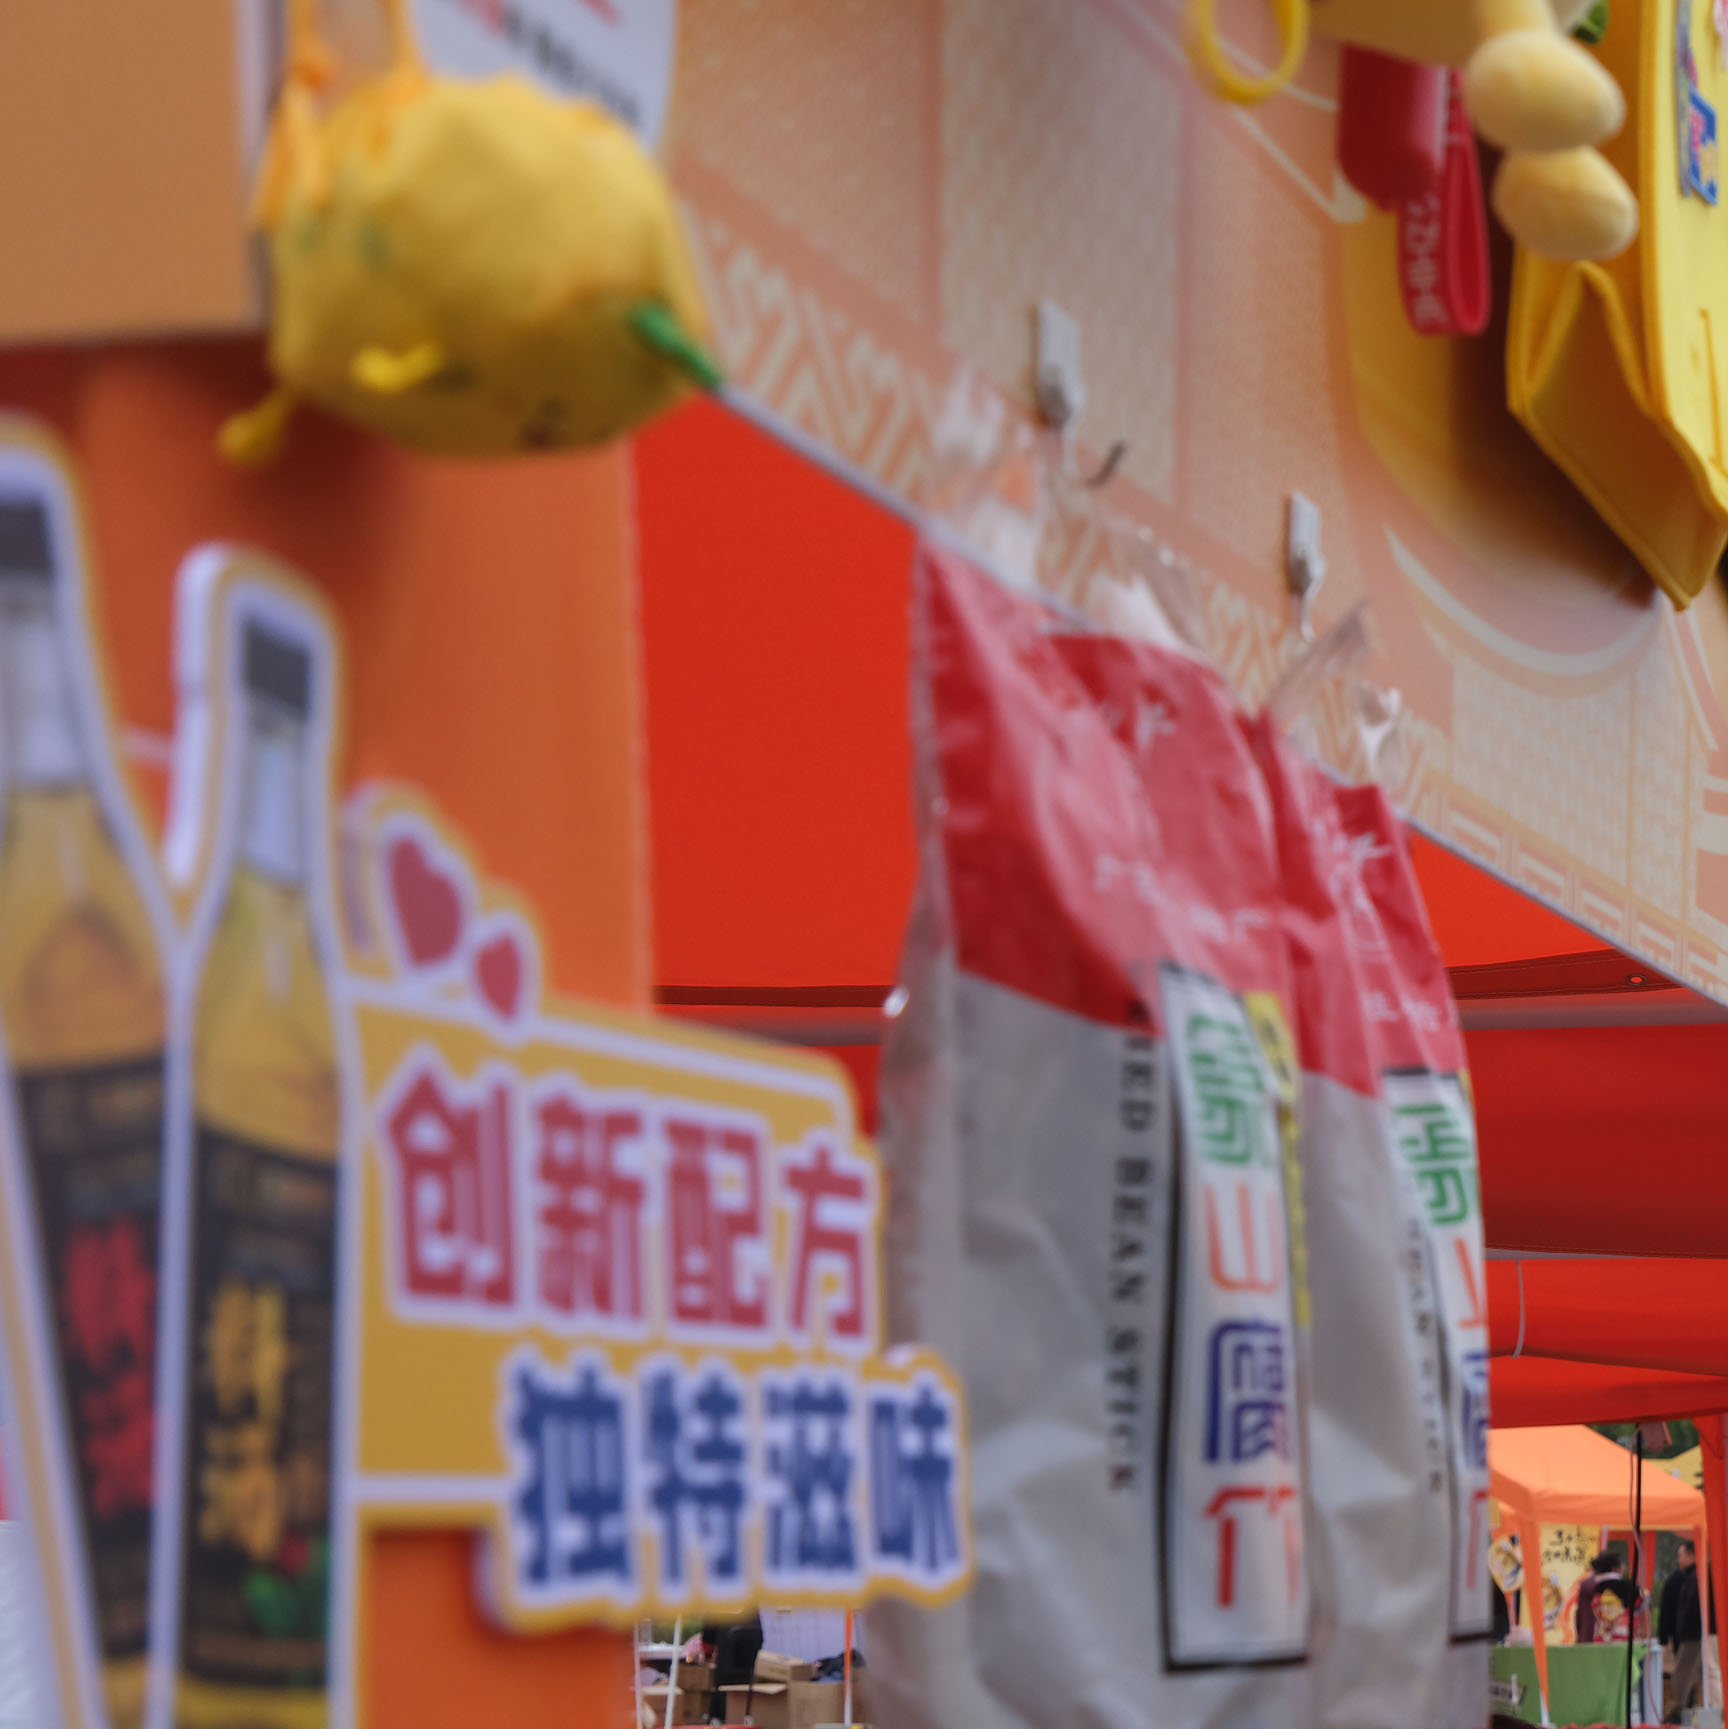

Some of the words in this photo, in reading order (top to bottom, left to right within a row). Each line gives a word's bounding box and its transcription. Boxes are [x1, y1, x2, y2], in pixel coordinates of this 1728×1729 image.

[386, 1067, 864, 1340] 创新配方
[514, 1362, 960, 1585] 独特滋味
